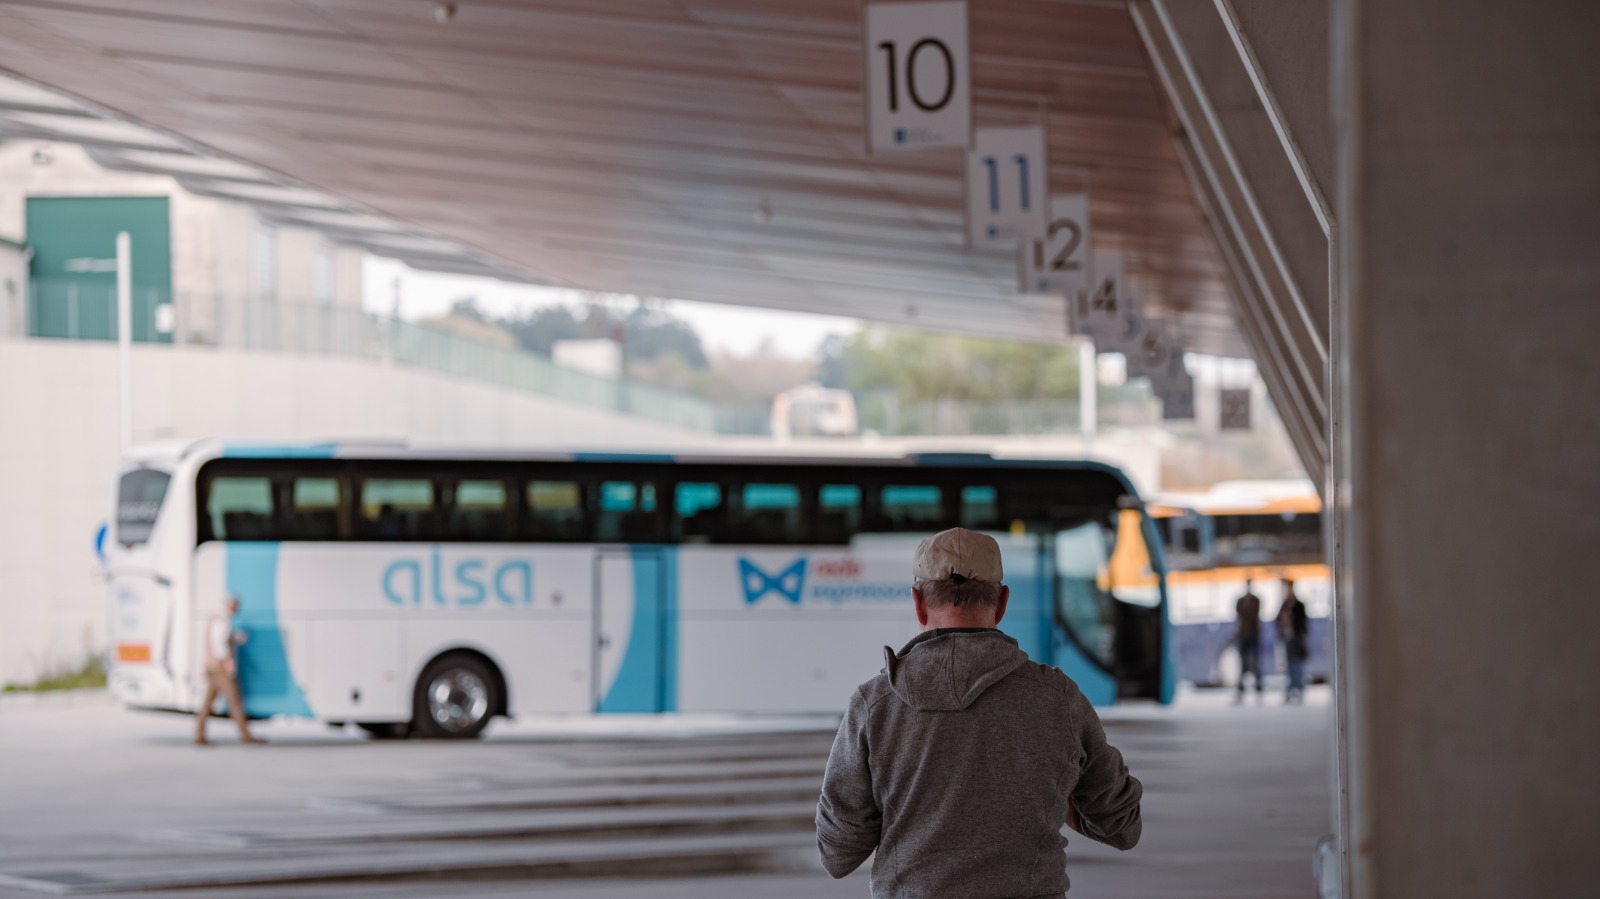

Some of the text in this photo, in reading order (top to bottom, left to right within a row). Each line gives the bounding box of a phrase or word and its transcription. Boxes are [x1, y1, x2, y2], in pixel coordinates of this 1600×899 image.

[876, 37, 956, 113] 10
[981, 154, 1031, 213] 11
[1033, 218, 1082, 271] 12
[381, 543, 532, 605] alsa
